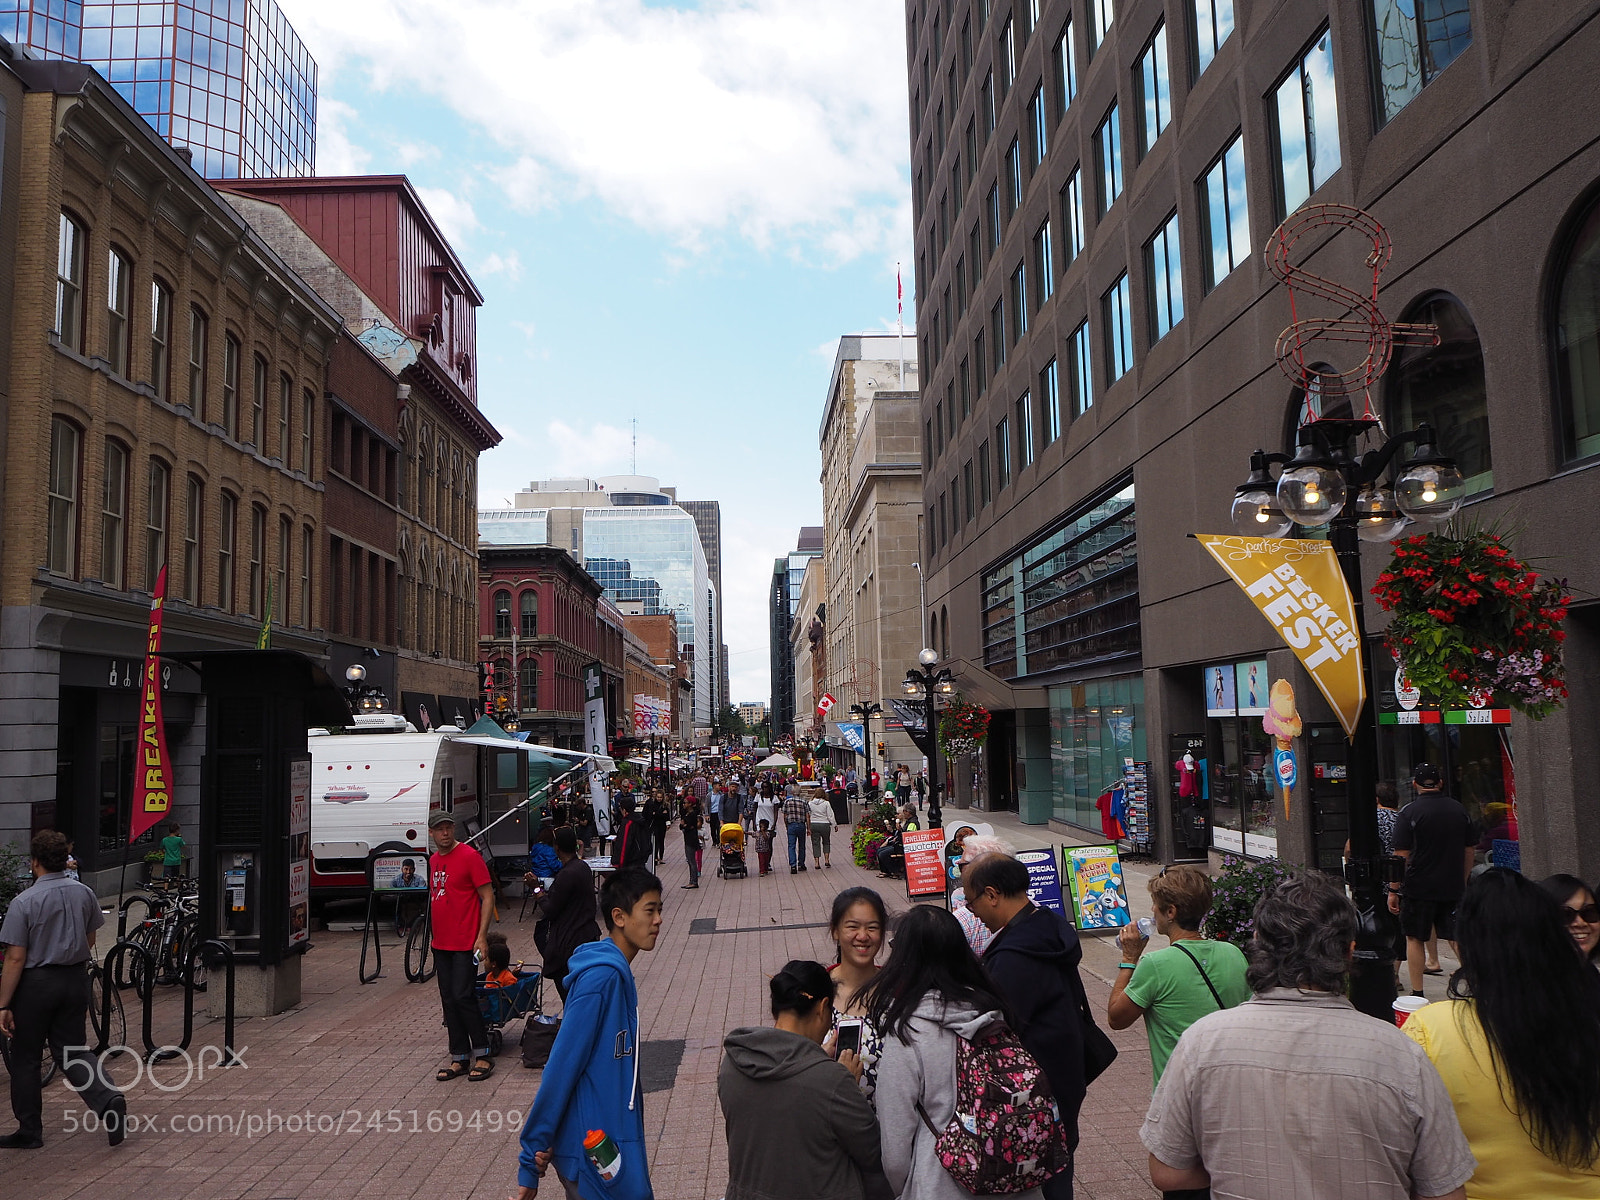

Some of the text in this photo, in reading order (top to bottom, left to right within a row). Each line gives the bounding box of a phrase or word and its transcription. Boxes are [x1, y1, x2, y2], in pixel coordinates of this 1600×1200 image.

[1222, 537, 1325, 561] Sparks Street
[1245, 573, 1342, 670] FEST
[143, 621, 169, 812] BREAKFAST
[1468, 711, 1490, 723] Salad
[904, 842, 937, 853] swatch
[1027, 865, 1055, 874] SPECIAL
[1079, 861, 1107, 873] SLUSH
